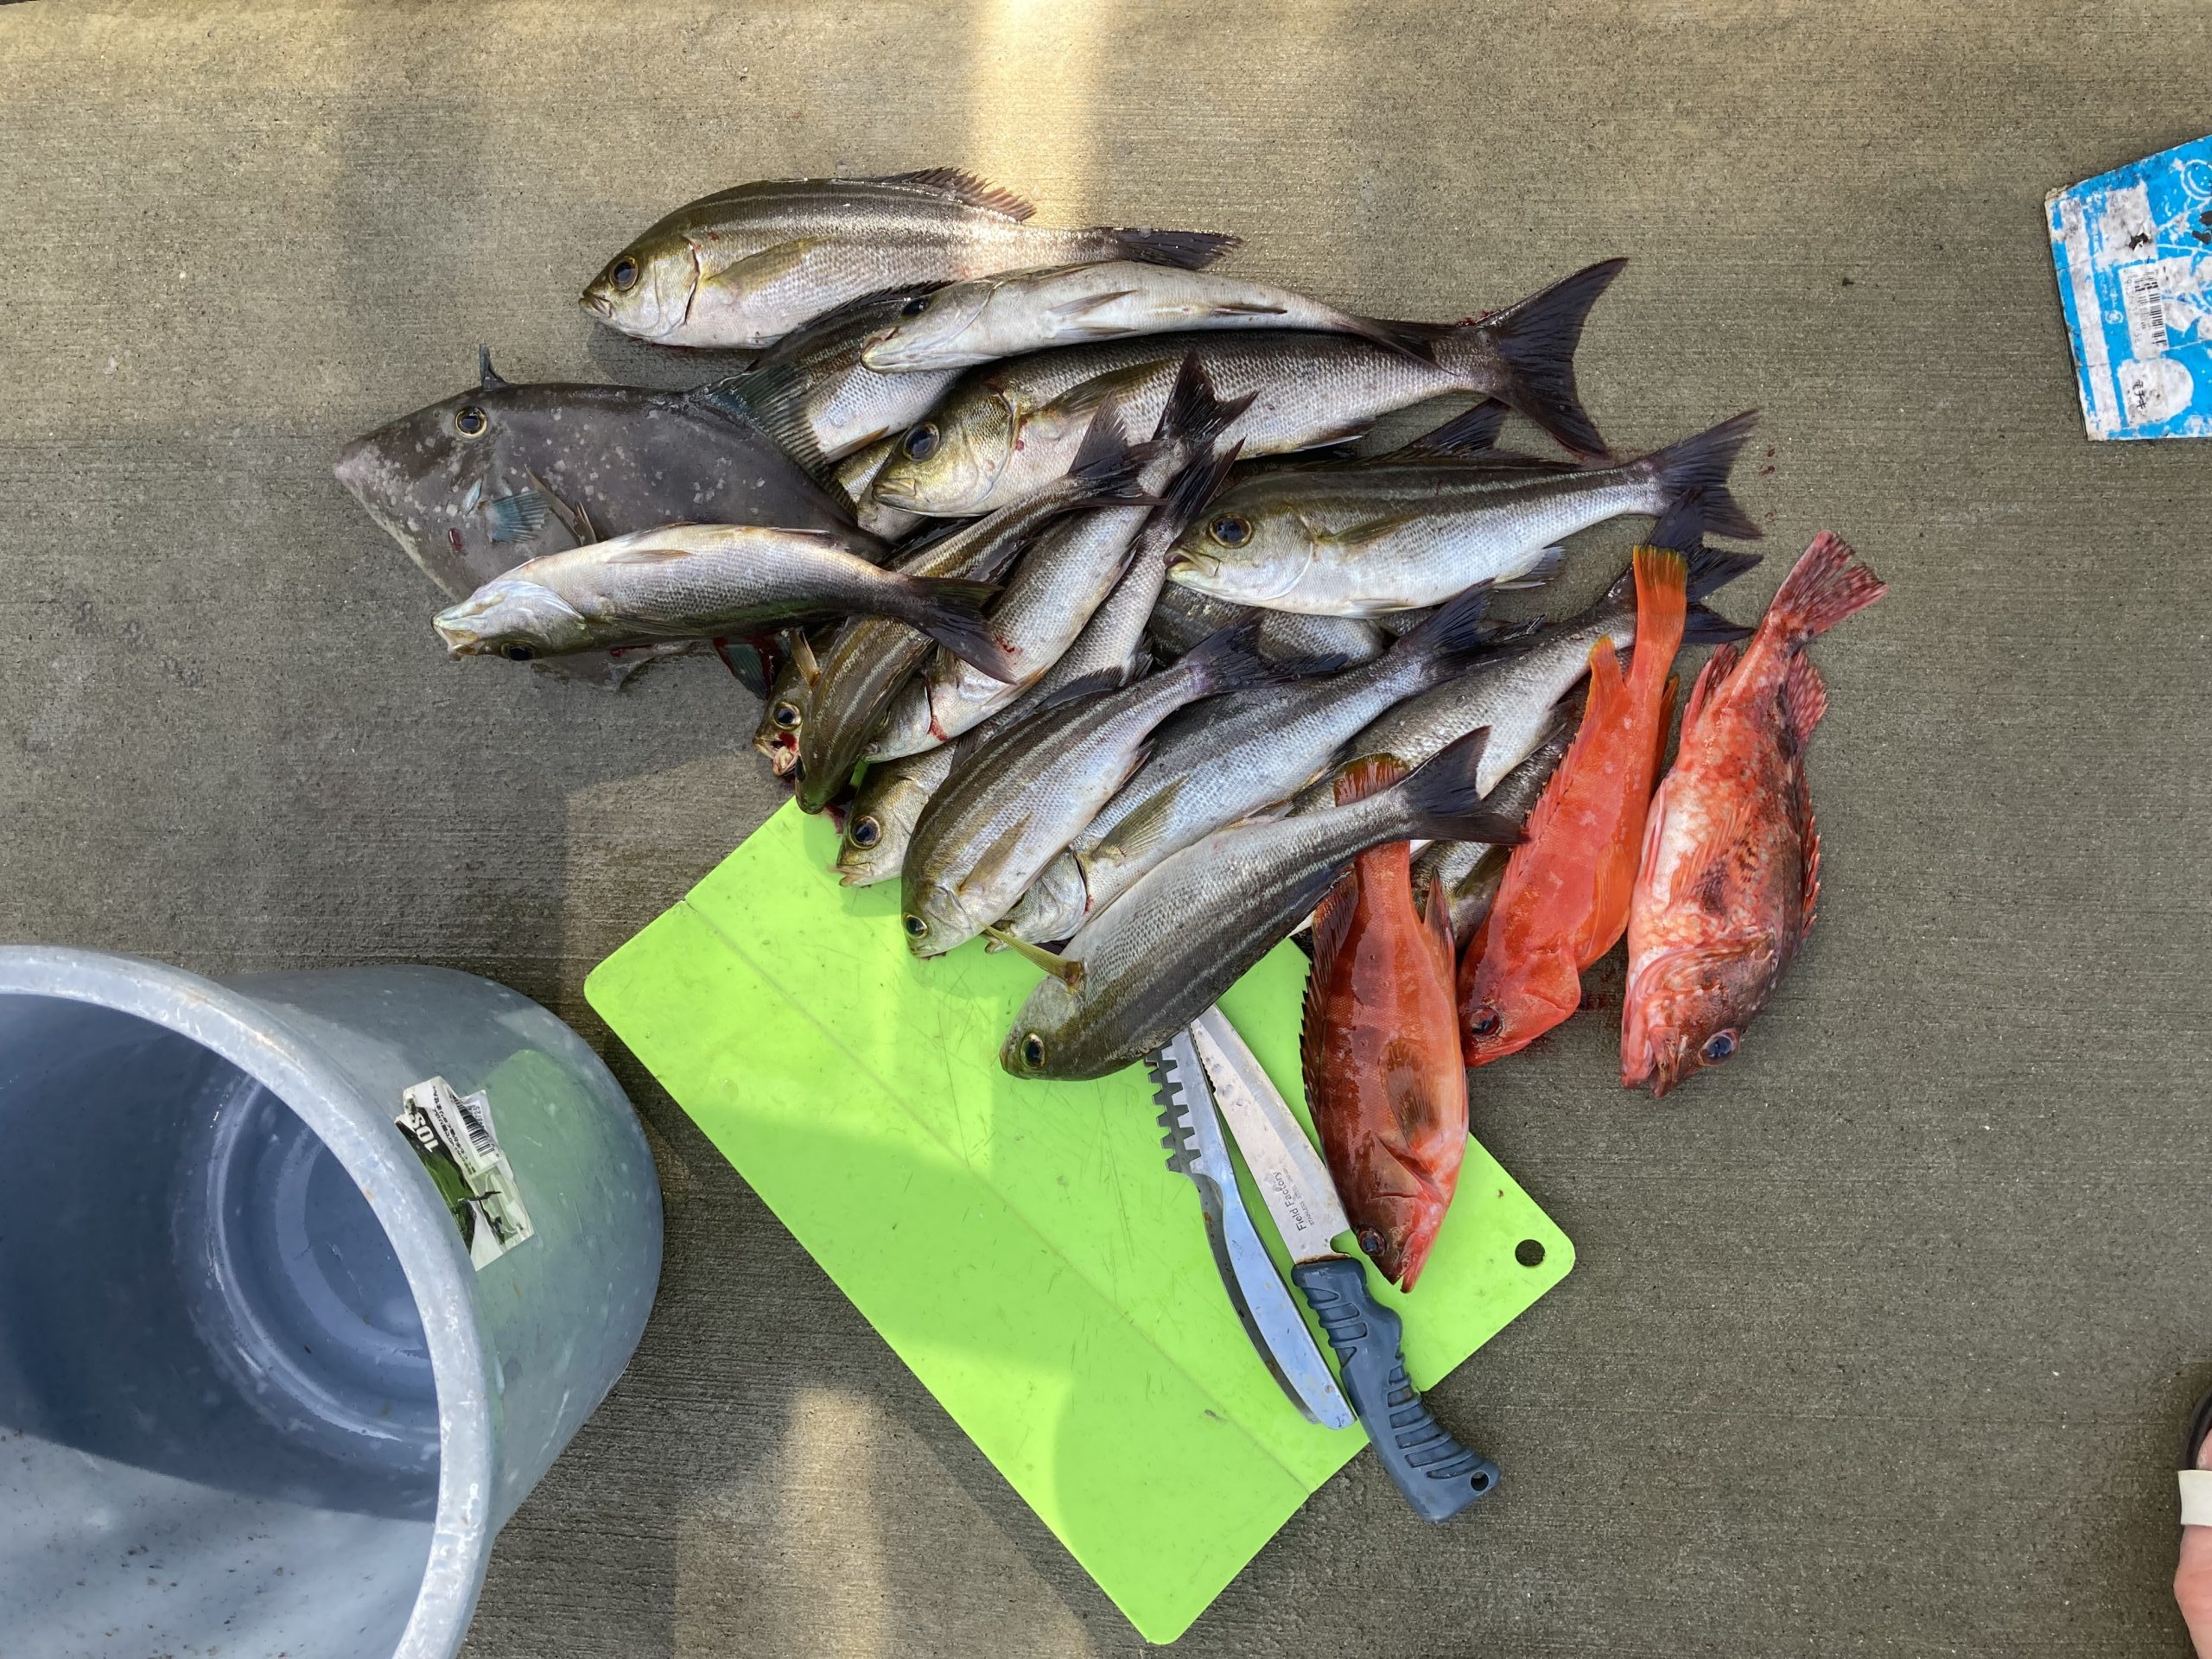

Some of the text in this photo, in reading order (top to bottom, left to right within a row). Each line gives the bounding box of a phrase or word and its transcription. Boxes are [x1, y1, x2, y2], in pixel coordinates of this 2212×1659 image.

[1273, 1172, 1306, 1231] Field Factory
[1292, 1185, 1301, 1199] STEEL
[1300, 1201, 1314, 1225] STAINLESS
